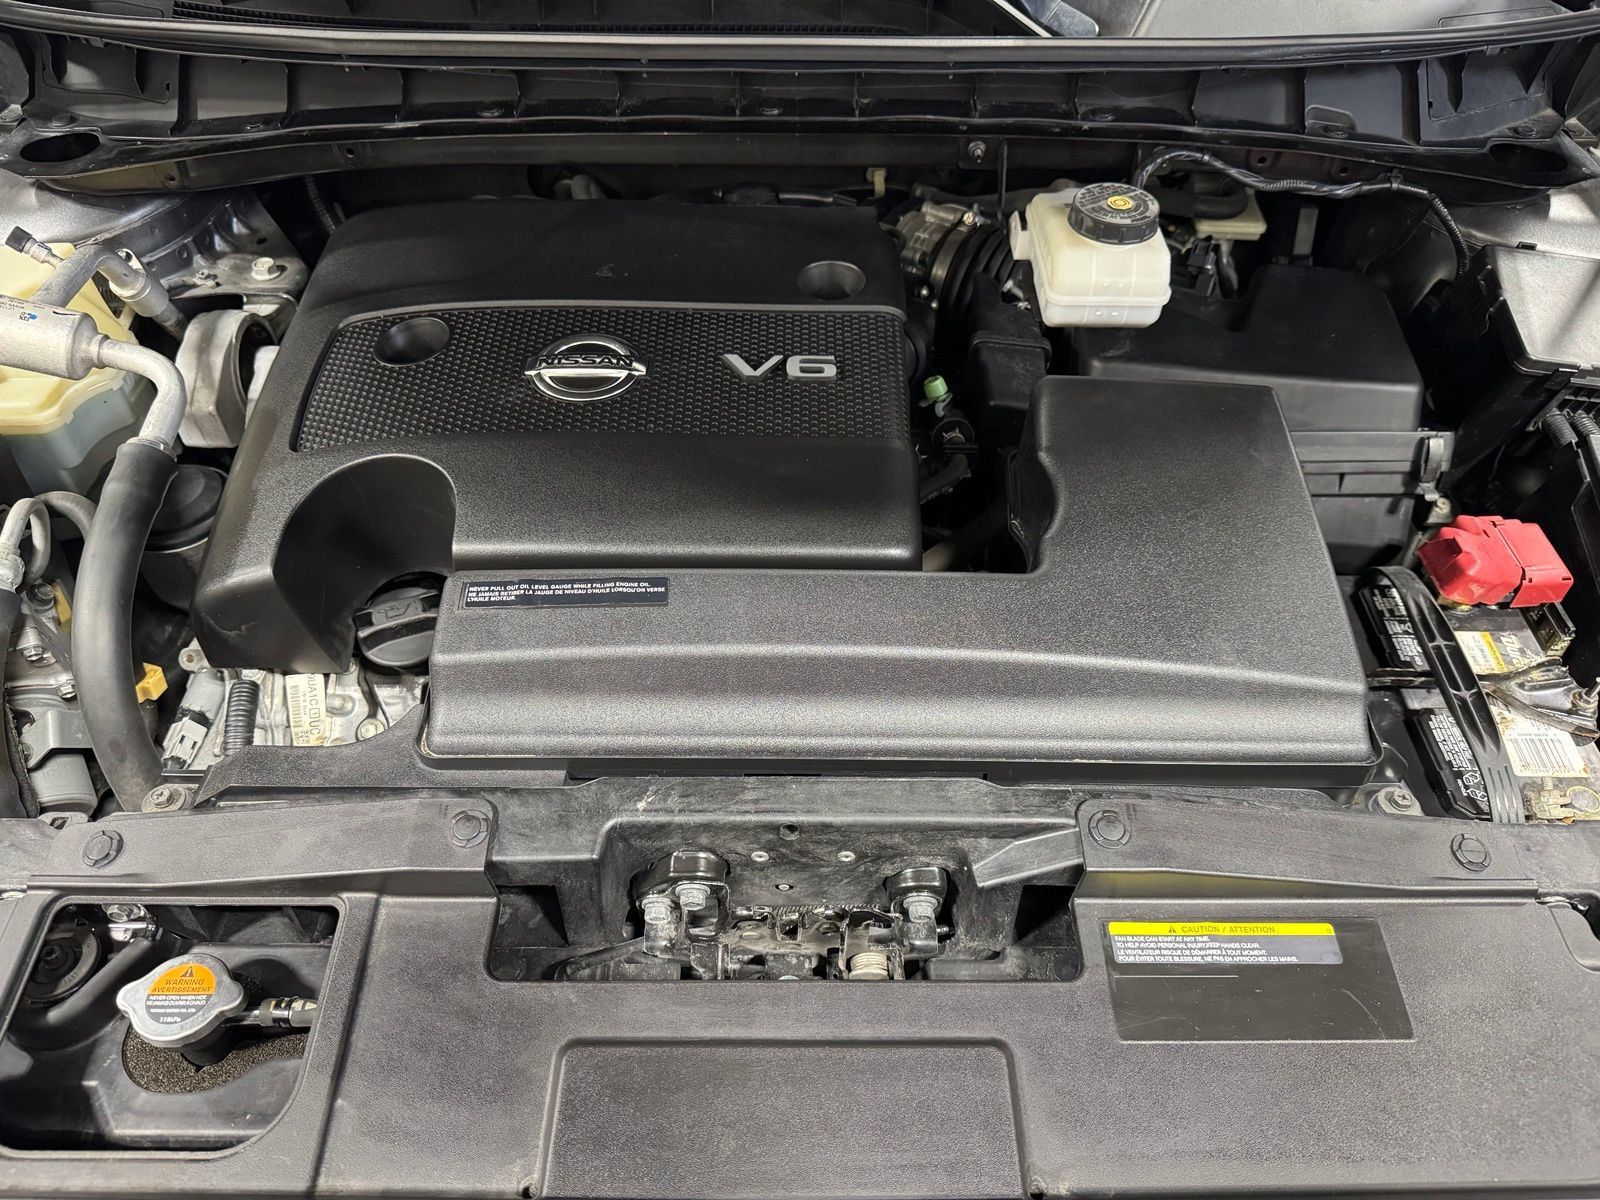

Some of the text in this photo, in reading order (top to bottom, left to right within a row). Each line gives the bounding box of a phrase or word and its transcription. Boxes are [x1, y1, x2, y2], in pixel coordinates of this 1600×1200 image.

[537, 356, 635, 368] NISSAN
[722, 353, 837, 381] V6
[165, 978, 206, 986] WARNING
